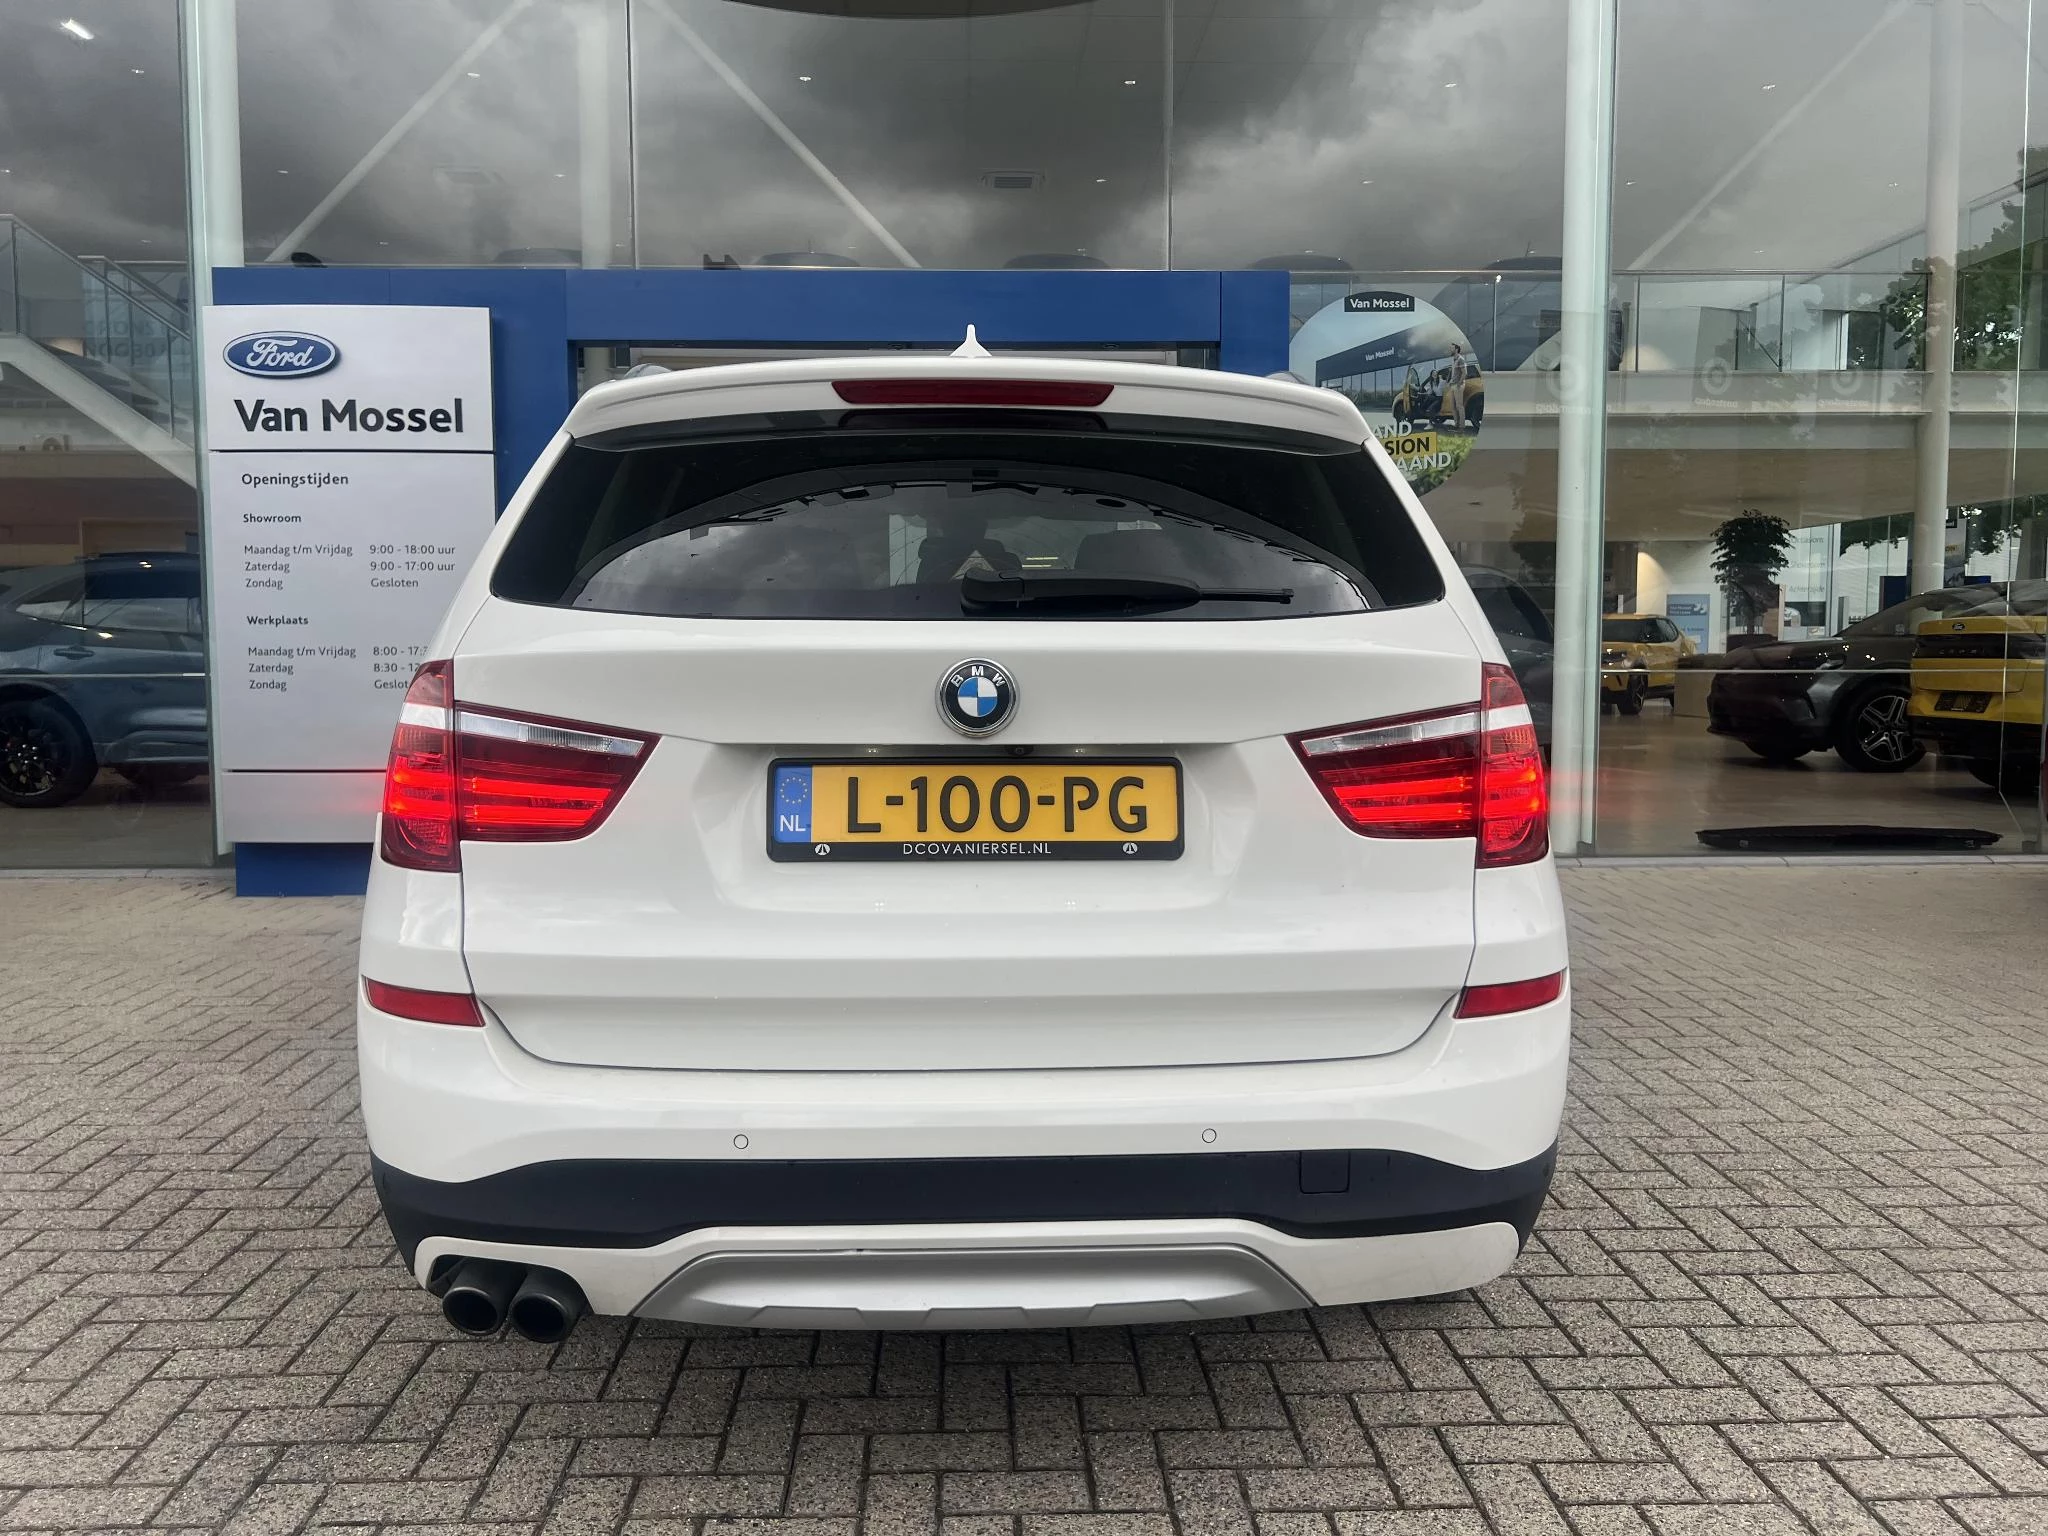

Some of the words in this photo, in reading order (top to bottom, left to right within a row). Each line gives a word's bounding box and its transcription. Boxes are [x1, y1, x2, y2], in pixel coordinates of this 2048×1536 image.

[1350, 298, 1370, 308] Van
[1372, 297, 1410, 308] Mossel
[246, 337, 314, 367] Ford
[233, 399, 308, 432] Van
[321, 398, 464, 433] Mossel
[1372, 420, 1412, 439] AND
[1384, 436, 1430, 455] SION
[1397, 451, 1452, 471] AAND
[241, 473, 349, 488] Openingstijden
[243, 513, 302, 523] Showroom
[244, 544, 291, 556] Maandag
[293, 544, 313, 555] t/m
[315, 543, 353, 557] Vrijdag
[369, 544, 394, 554] 9:00
[404, 544, 435, 554] 18:00
[437, 546, 456, 555] uur
[244, 561, 290, 573] Zaterdag
[370, 561, 395, 571] 9:00
[406, 561, 434, 571] 17:00
[437, 563, 456, 571] uur
[245, 578, 283, 590] Zondag
[370, 578, 419, 588] Gesloten
[247, 615, 309, 627] Werkplaats
[248, 647, 294, 658] Maandag
[296, 646, 316, 656] t/m
[318, 646, 356, 659] Vrijdag
[373, 646, 398, 656] 8:00
[248, 663, 293, 675] Zaterdag
[373, 662, 398, 672] 8:30
[951, 665, 1006, 688] BMW
[249, 680, 287, 692] Zondag
[374, 679, 409, 689] Geslot
[847, 775, 1148, 833] L-100-PG
[779, 814, 806, 832] NL
[902, 842, 1052, 855] DCOVANIERSEL.NL
